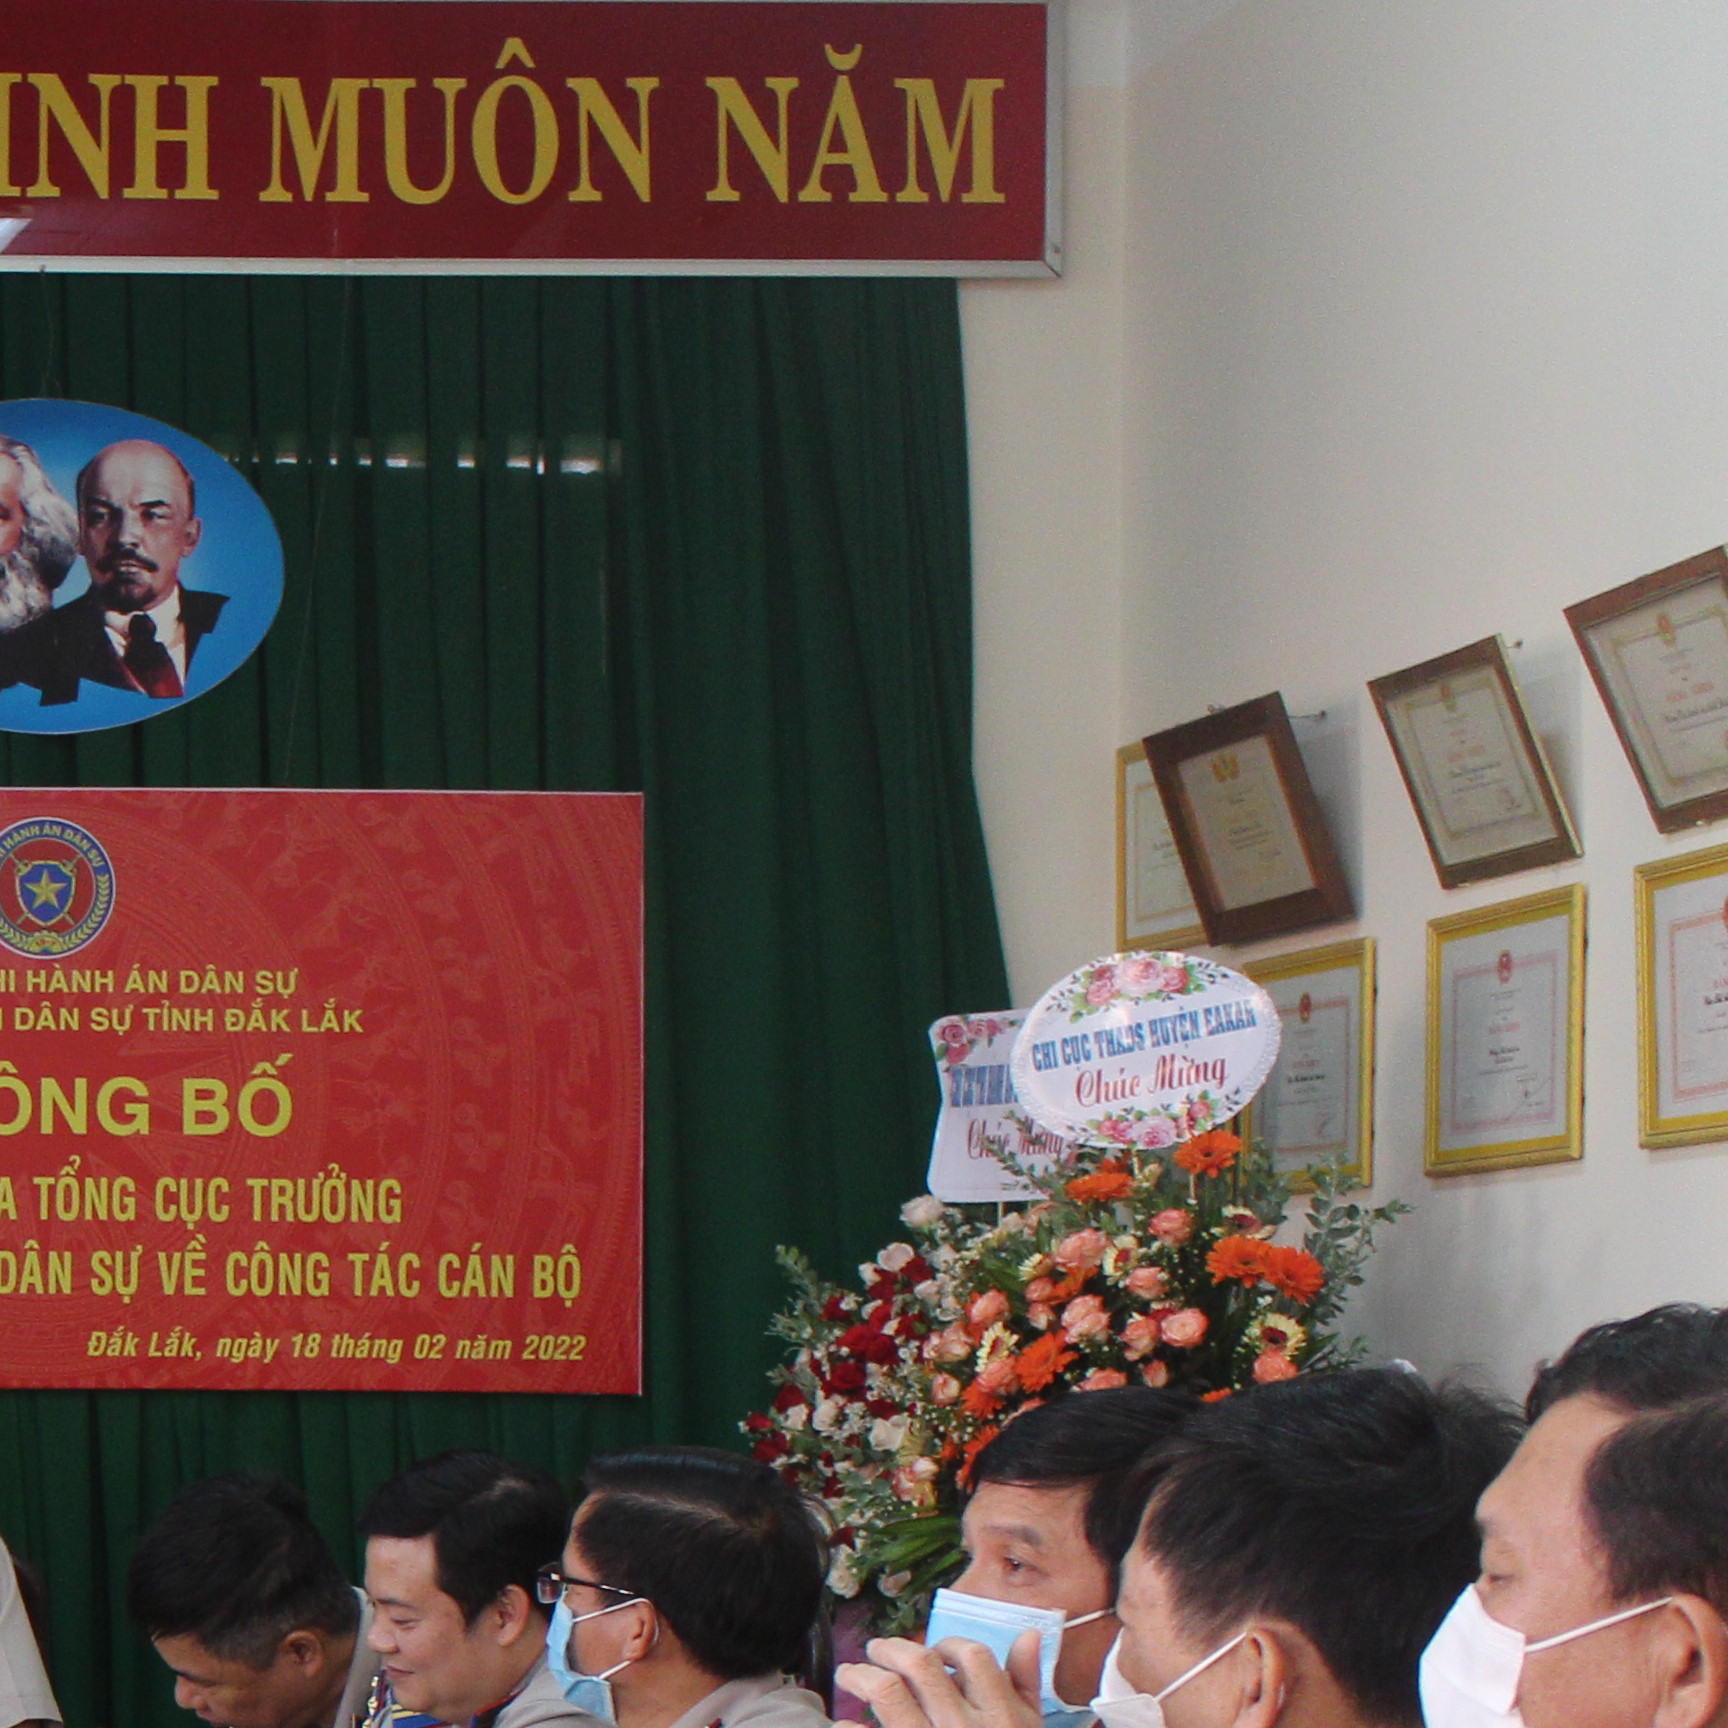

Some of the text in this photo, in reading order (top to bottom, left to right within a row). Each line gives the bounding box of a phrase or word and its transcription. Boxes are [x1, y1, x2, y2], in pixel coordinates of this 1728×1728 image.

[260, 38, 660, 205] MUÔN
[707, 44, 1006, 204] NĂM
[26, 955, 117, 995] HÀNH
[124, 963, 171, 996] ÁN
[179, 964, 246, 996] DÂN
[254, 967, 301, 1003] SỰ
[14, 1000, 81, 1033] DÂN
[90, 1004, 136, 1037] SỰ
[142, 998, 216, 1034] TỈNH
[224, 997, 293, 1034] ĐẮK
[301, 997, 366, 1034] LẮK
[1032, 1040, 1059, 1072] CHI
[1076, 1067, 1143, 1107] Chúc
[1147, 1053, 1228, 1095] Mừng
[182, 1053, 296, 1138] BỐ
[32, 1155, 139, 1223] TỔNG
[154, 1176, 232, 1232] CỤC
[245, 1163, 404, 1226] TRƯỞNG
[90, 1247, 145, 1307] SỰ
[158, 1238, 209, 1297] VỀ
[225, 1240, 332, 1299] CÔNG
[347, 1241, 423, 1300] TÁC
[438, 1242, 517, 1300] CÁN
[533, 1244, 583, 1308] BỘ
[87, 1328, 588, 1366] Đắk Lắk, ngày 18 tháng 02 năm 2022
